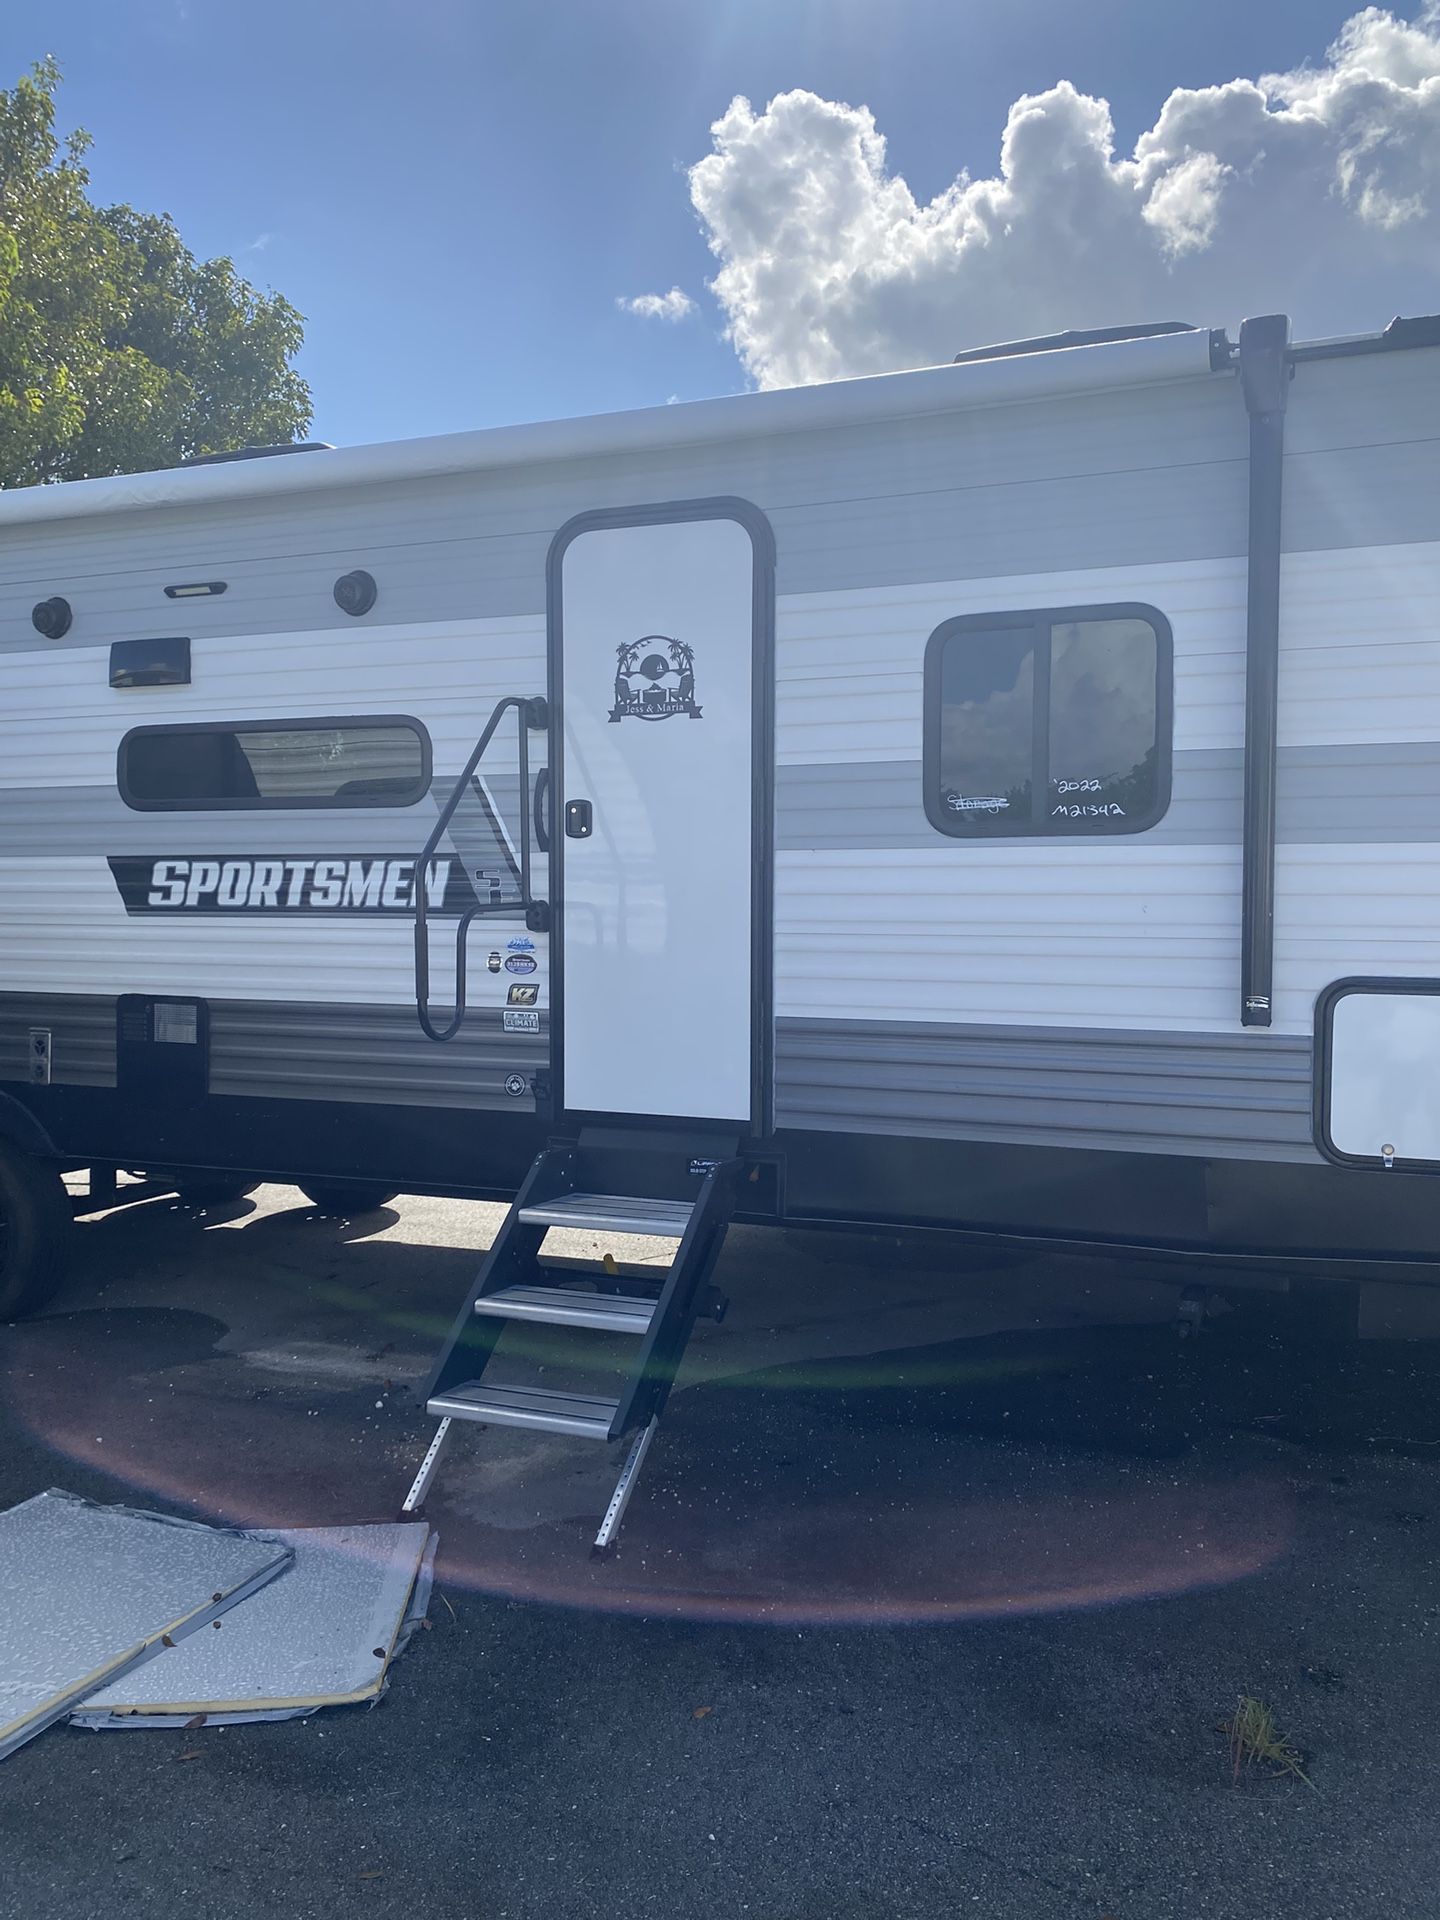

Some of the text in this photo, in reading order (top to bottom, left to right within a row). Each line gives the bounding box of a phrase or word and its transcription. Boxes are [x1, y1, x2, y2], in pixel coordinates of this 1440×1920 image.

[626, 703, 685, 714] Jess & Maria
[148, 860, 452, 908] SPORTSMEN
[511, 987, 535, 1002] KZ
[505, 1018, 537, 1028] CLIMATE
